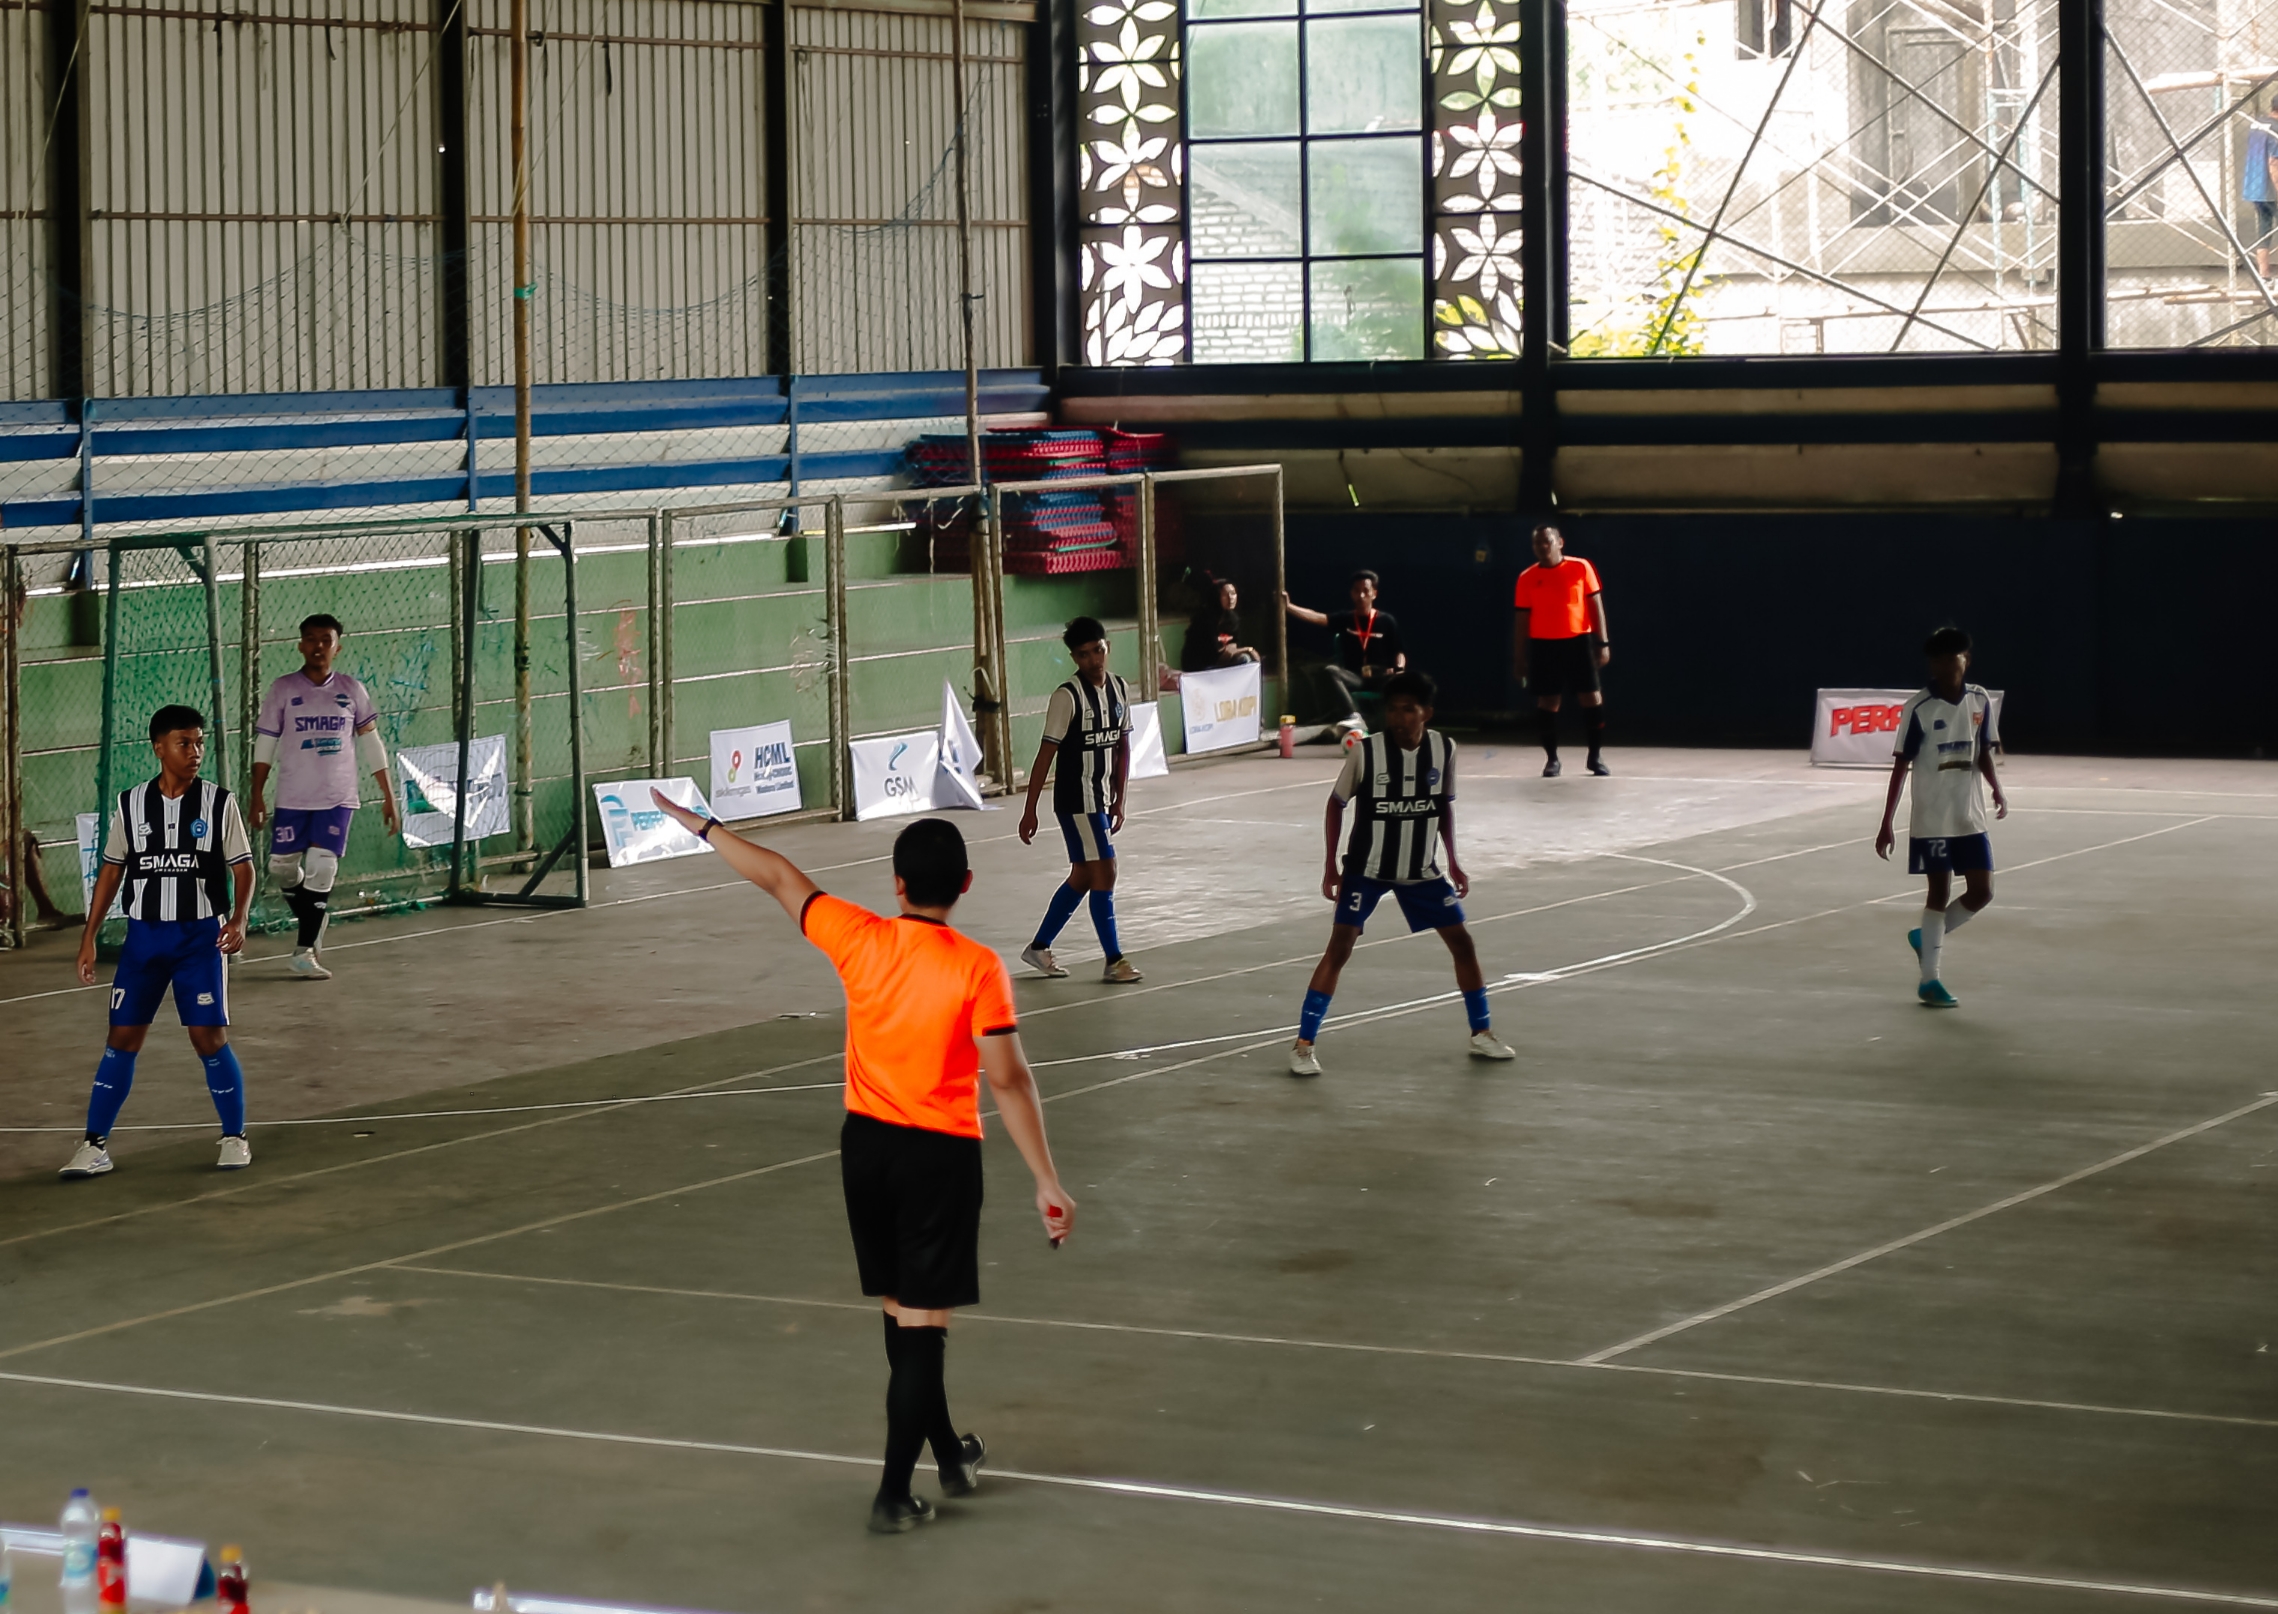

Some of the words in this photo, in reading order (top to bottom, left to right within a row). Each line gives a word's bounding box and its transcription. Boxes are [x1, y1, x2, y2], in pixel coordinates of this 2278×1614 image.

[754, 741, 791, 769] HCML
[884, 776, 918, 798] GSM
[1375, 799, 1436, 814] SMAGA
[275, 825, 295, 843] 30
[1928, 839, 1947, 858] 72
[139, 852, 200, 871] SMAGA
[1349, 892, 1362, 912] 3
[110, 987, 125, 1010] 17
